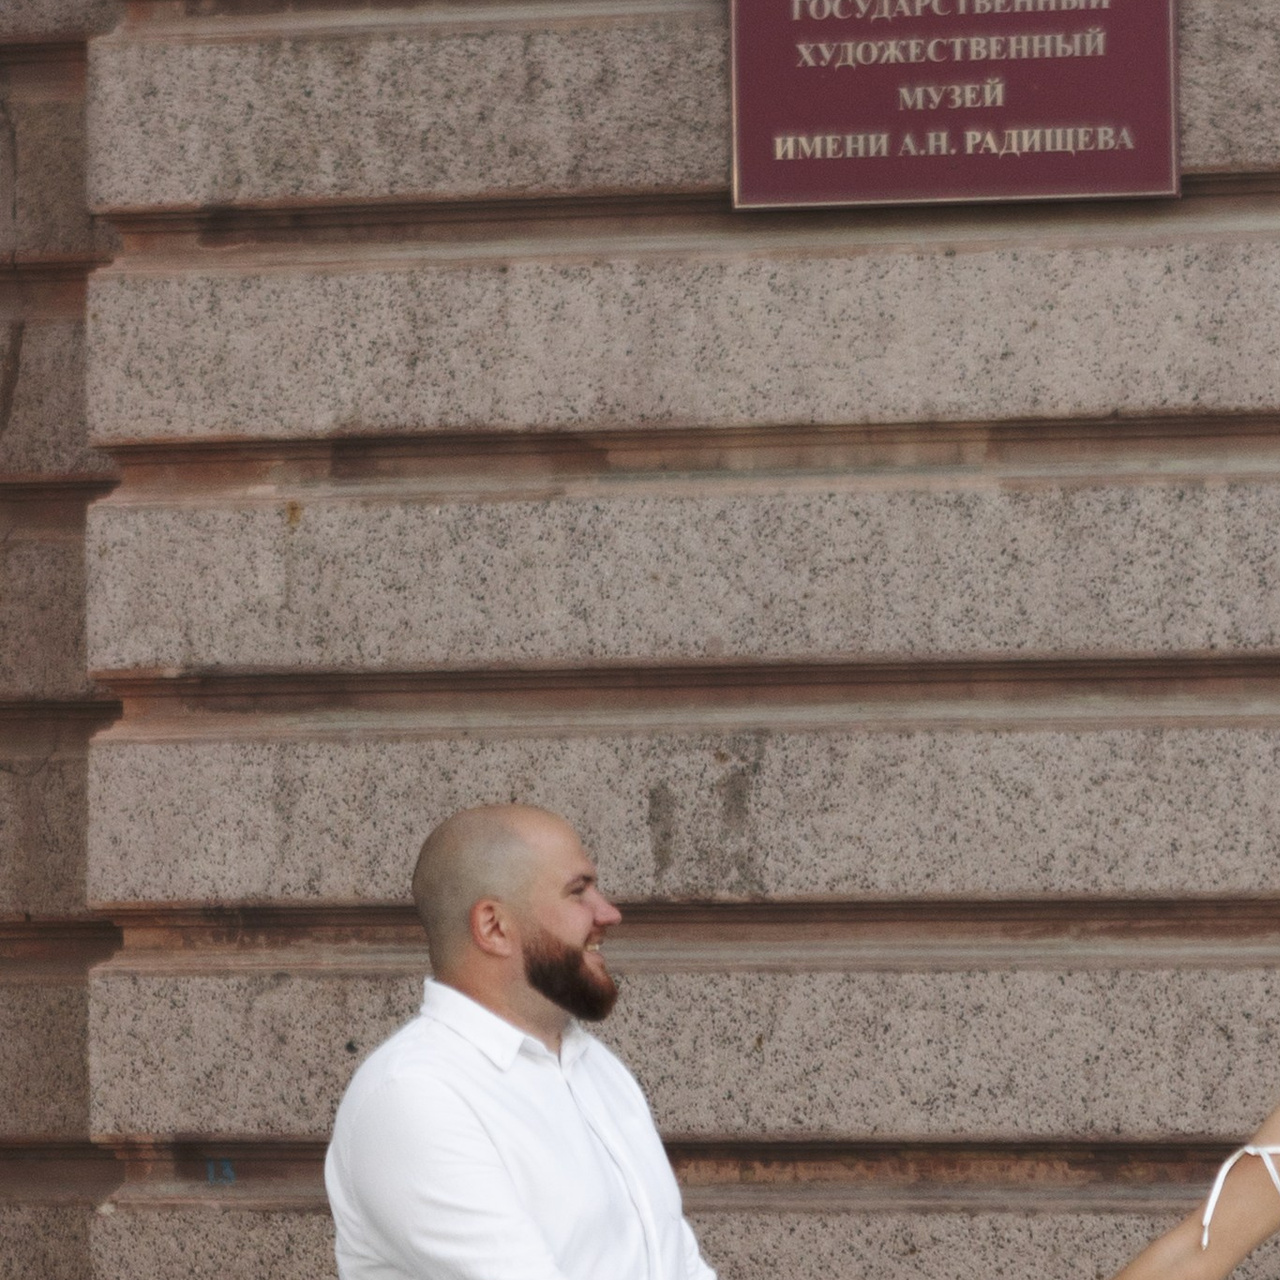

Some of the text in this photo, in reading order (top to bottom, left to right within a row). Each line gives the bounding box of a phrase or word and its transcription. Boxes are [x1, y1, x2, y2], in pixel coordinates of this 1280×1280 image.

[796, 28, 1106, 70] ХУДОЖЕСТВЕННЫЙ
[898, 78, 1004, 110] МУЗЕЙ
[773, 126, 1134, 161] ИМЕНИ А.Н. РАДИЩЕВА
